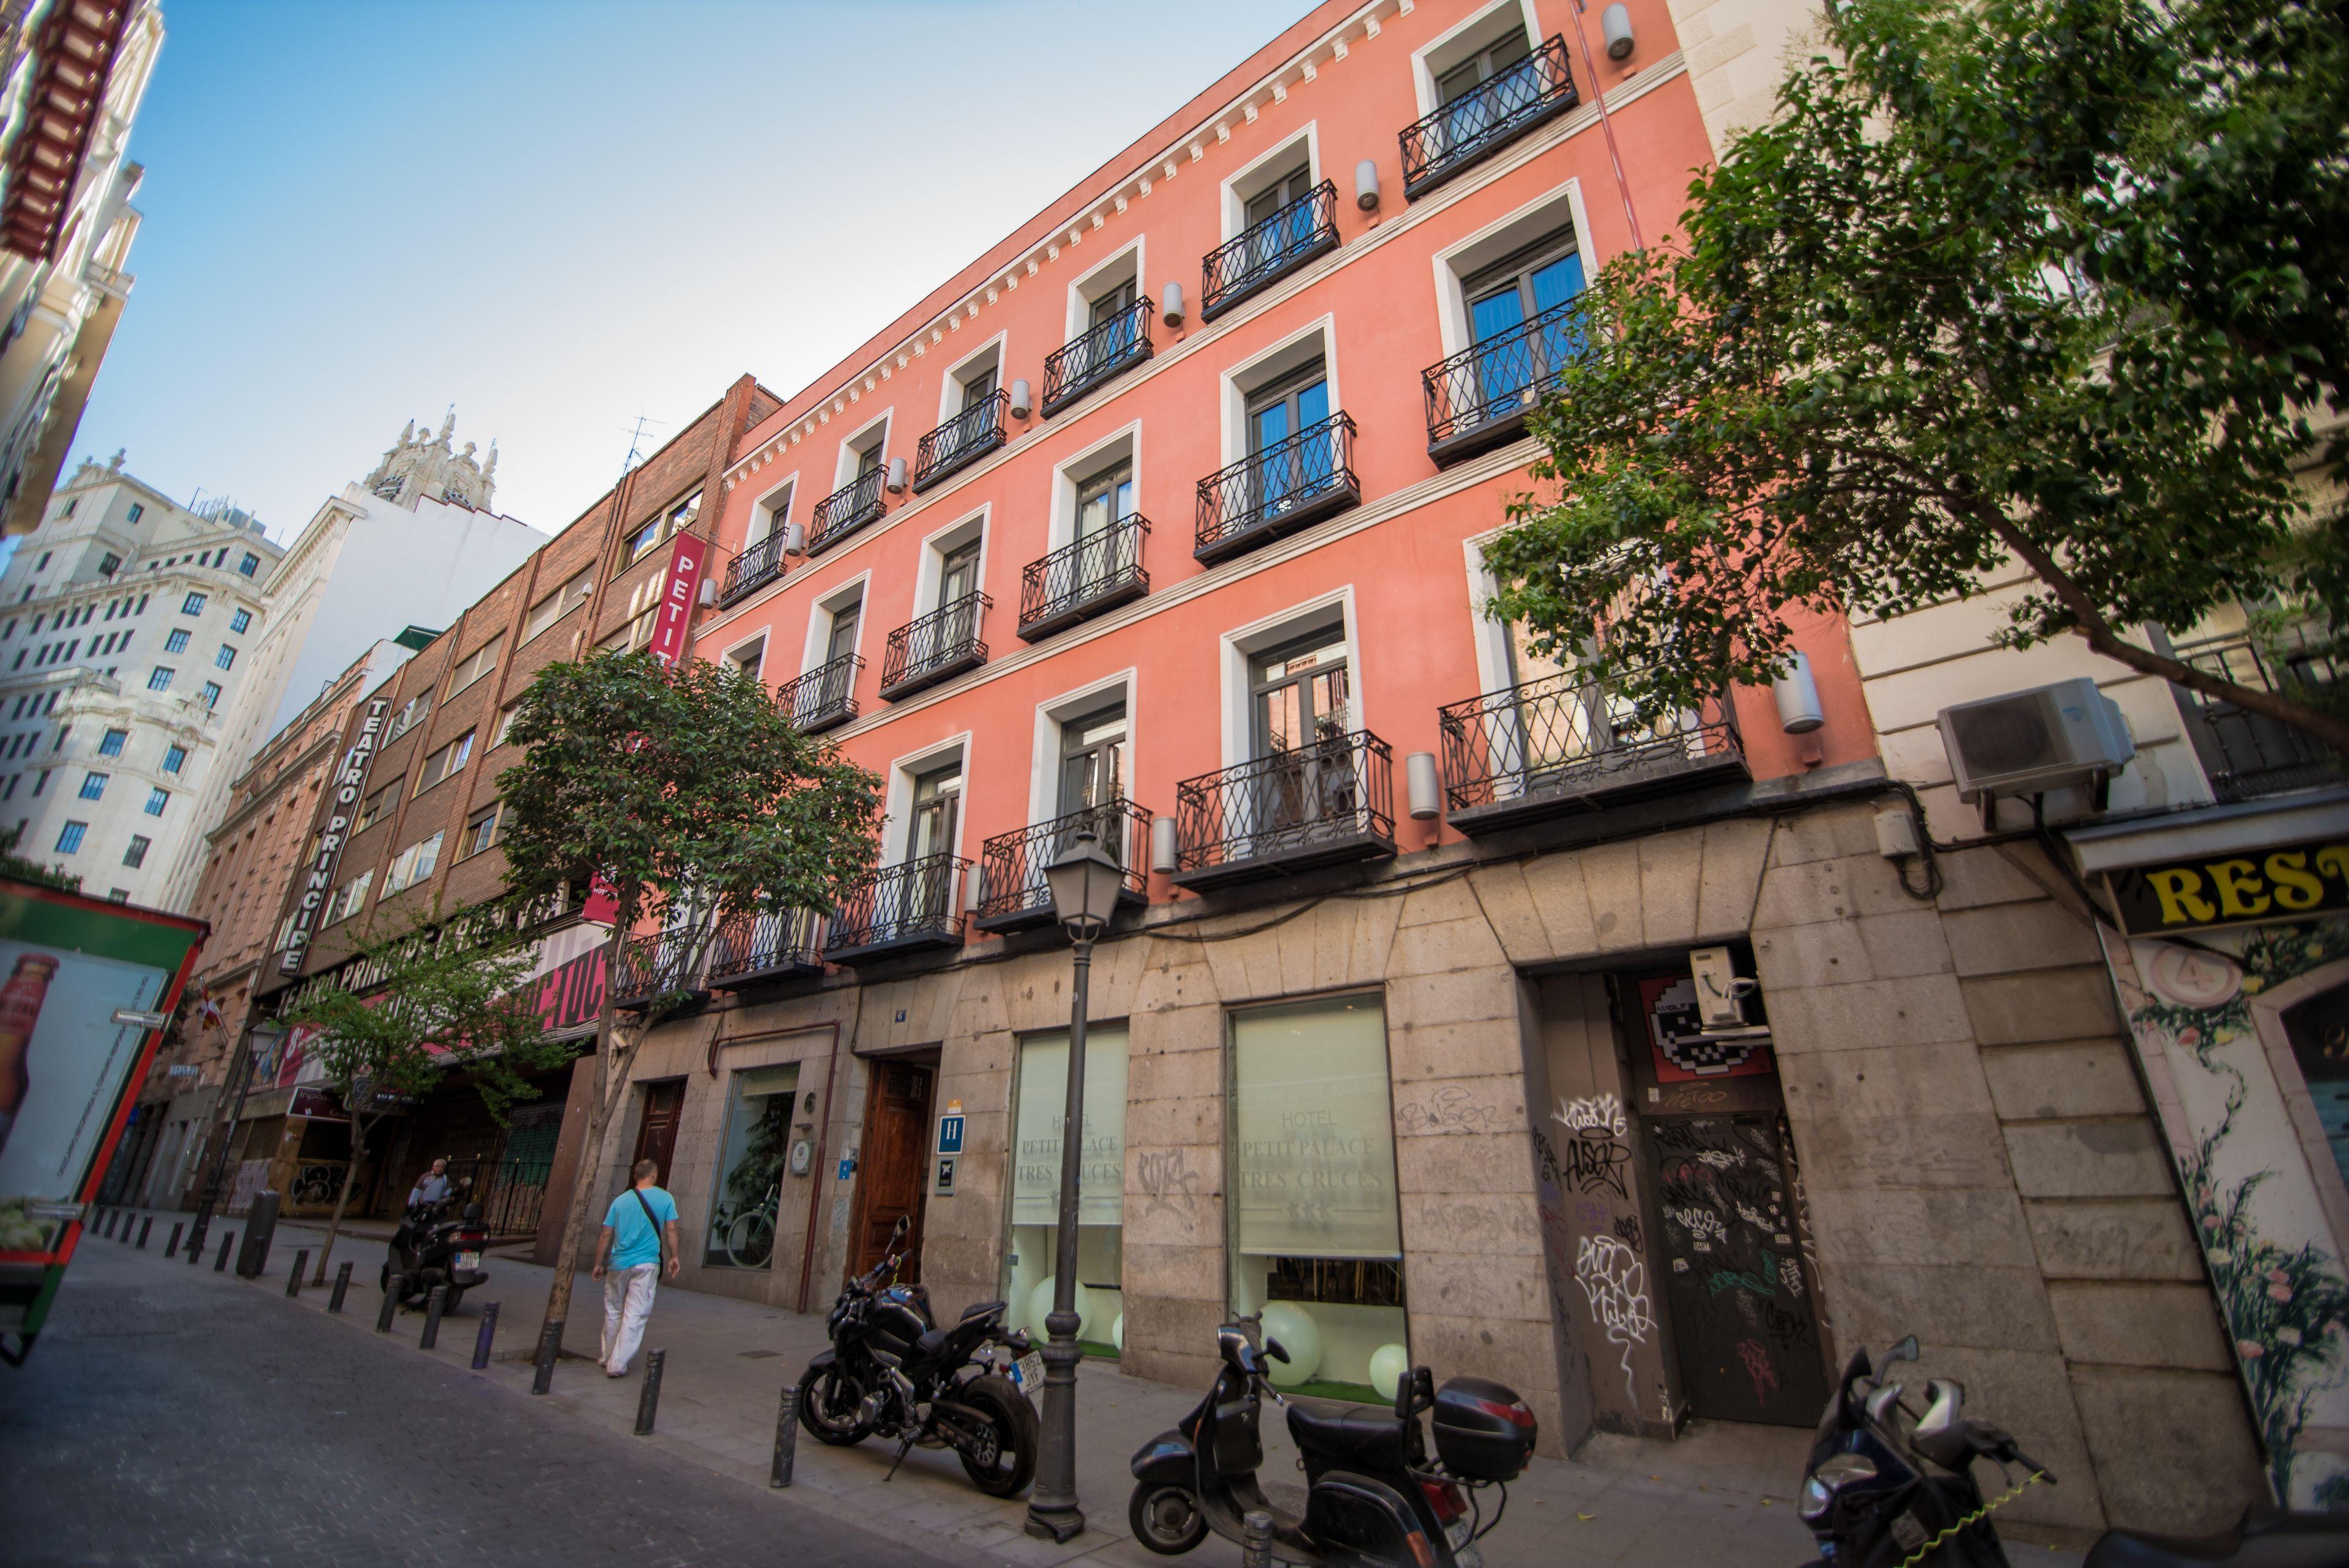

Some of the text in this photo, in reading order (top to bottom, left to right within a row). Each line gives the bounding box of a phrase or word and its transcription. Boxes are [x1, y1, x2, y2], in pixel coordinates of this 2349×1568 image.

[657, 555, 694, 666] PETIT
[340, 700, 387, 804] TEATRO
[281, 816, 346, 970] PRINCIPE
[434, 903, 506, 961] GRN
[897, 1011, 903, 1020] 6
[804, 1091, 817, 1115] 6
[1053, 1113, 1092, 1129] HOL
[1282, 1110, 1337, 1128] HOTEL
[946, 1120, 958, 1140] H
[1022, 1136, 1117, 1154] PETIT LACE
[1243, 1137, 1375, 1157] PETIT PALACE
[1017, 1162, 1121, 1180] TRES UCES
[1239, 1169, 1383, 1189] TRES CRUCES
[1019, 1353, 1041, 1373] 3852
[1026, 1368, 1039, 1386] JYF
